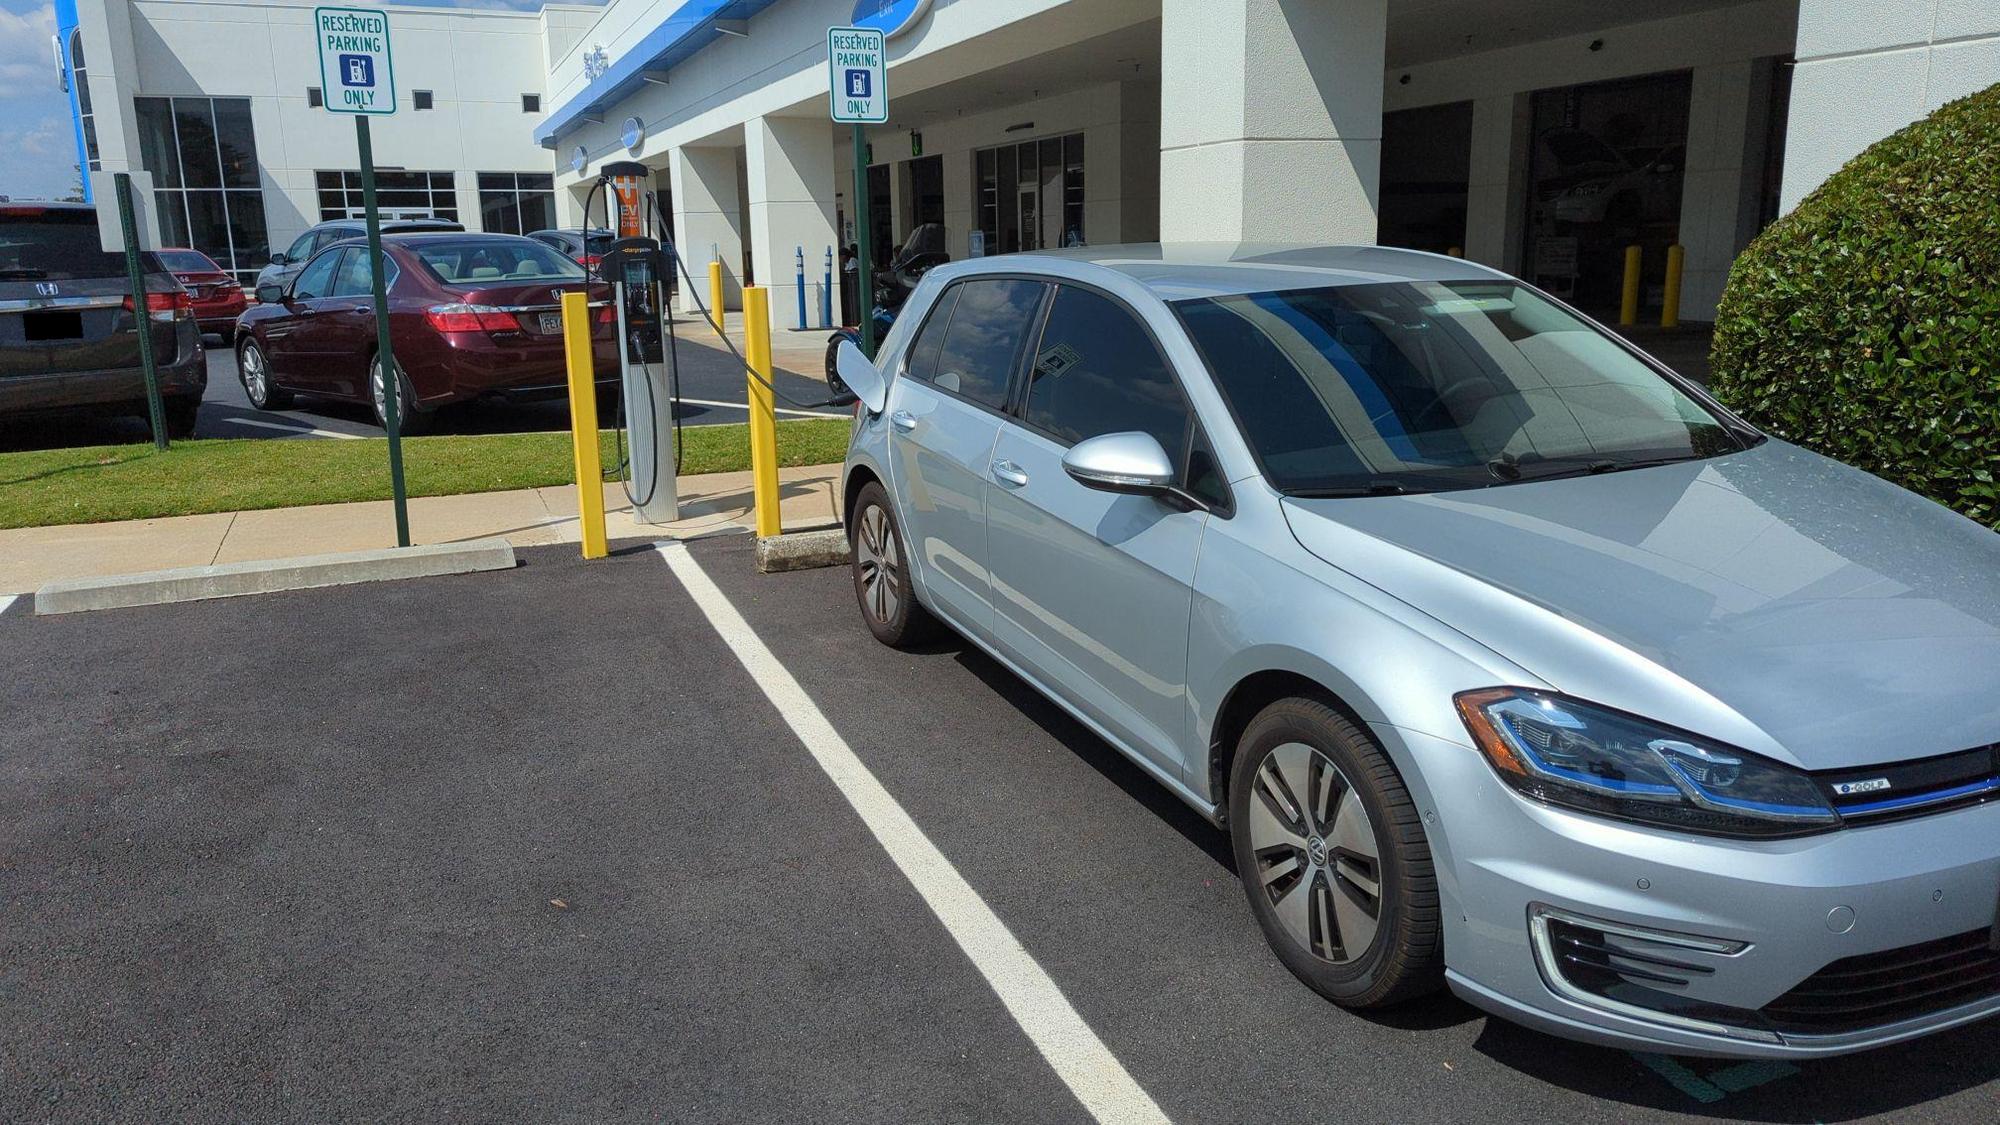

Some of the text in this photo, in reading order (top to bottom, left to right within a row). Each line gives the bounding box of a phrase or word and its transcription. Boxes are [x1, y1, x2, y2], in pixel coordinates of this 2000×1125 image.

[322, 15, 382, 33] RESERVED
[327, 35, 381, 52] PARKING
[833, 35, 879, 50] RESERVED
[837, 52, 877, 67] PARKING
[344, 89, 375, 105] ONLY
[847, 100, 871, 114] ONLY
